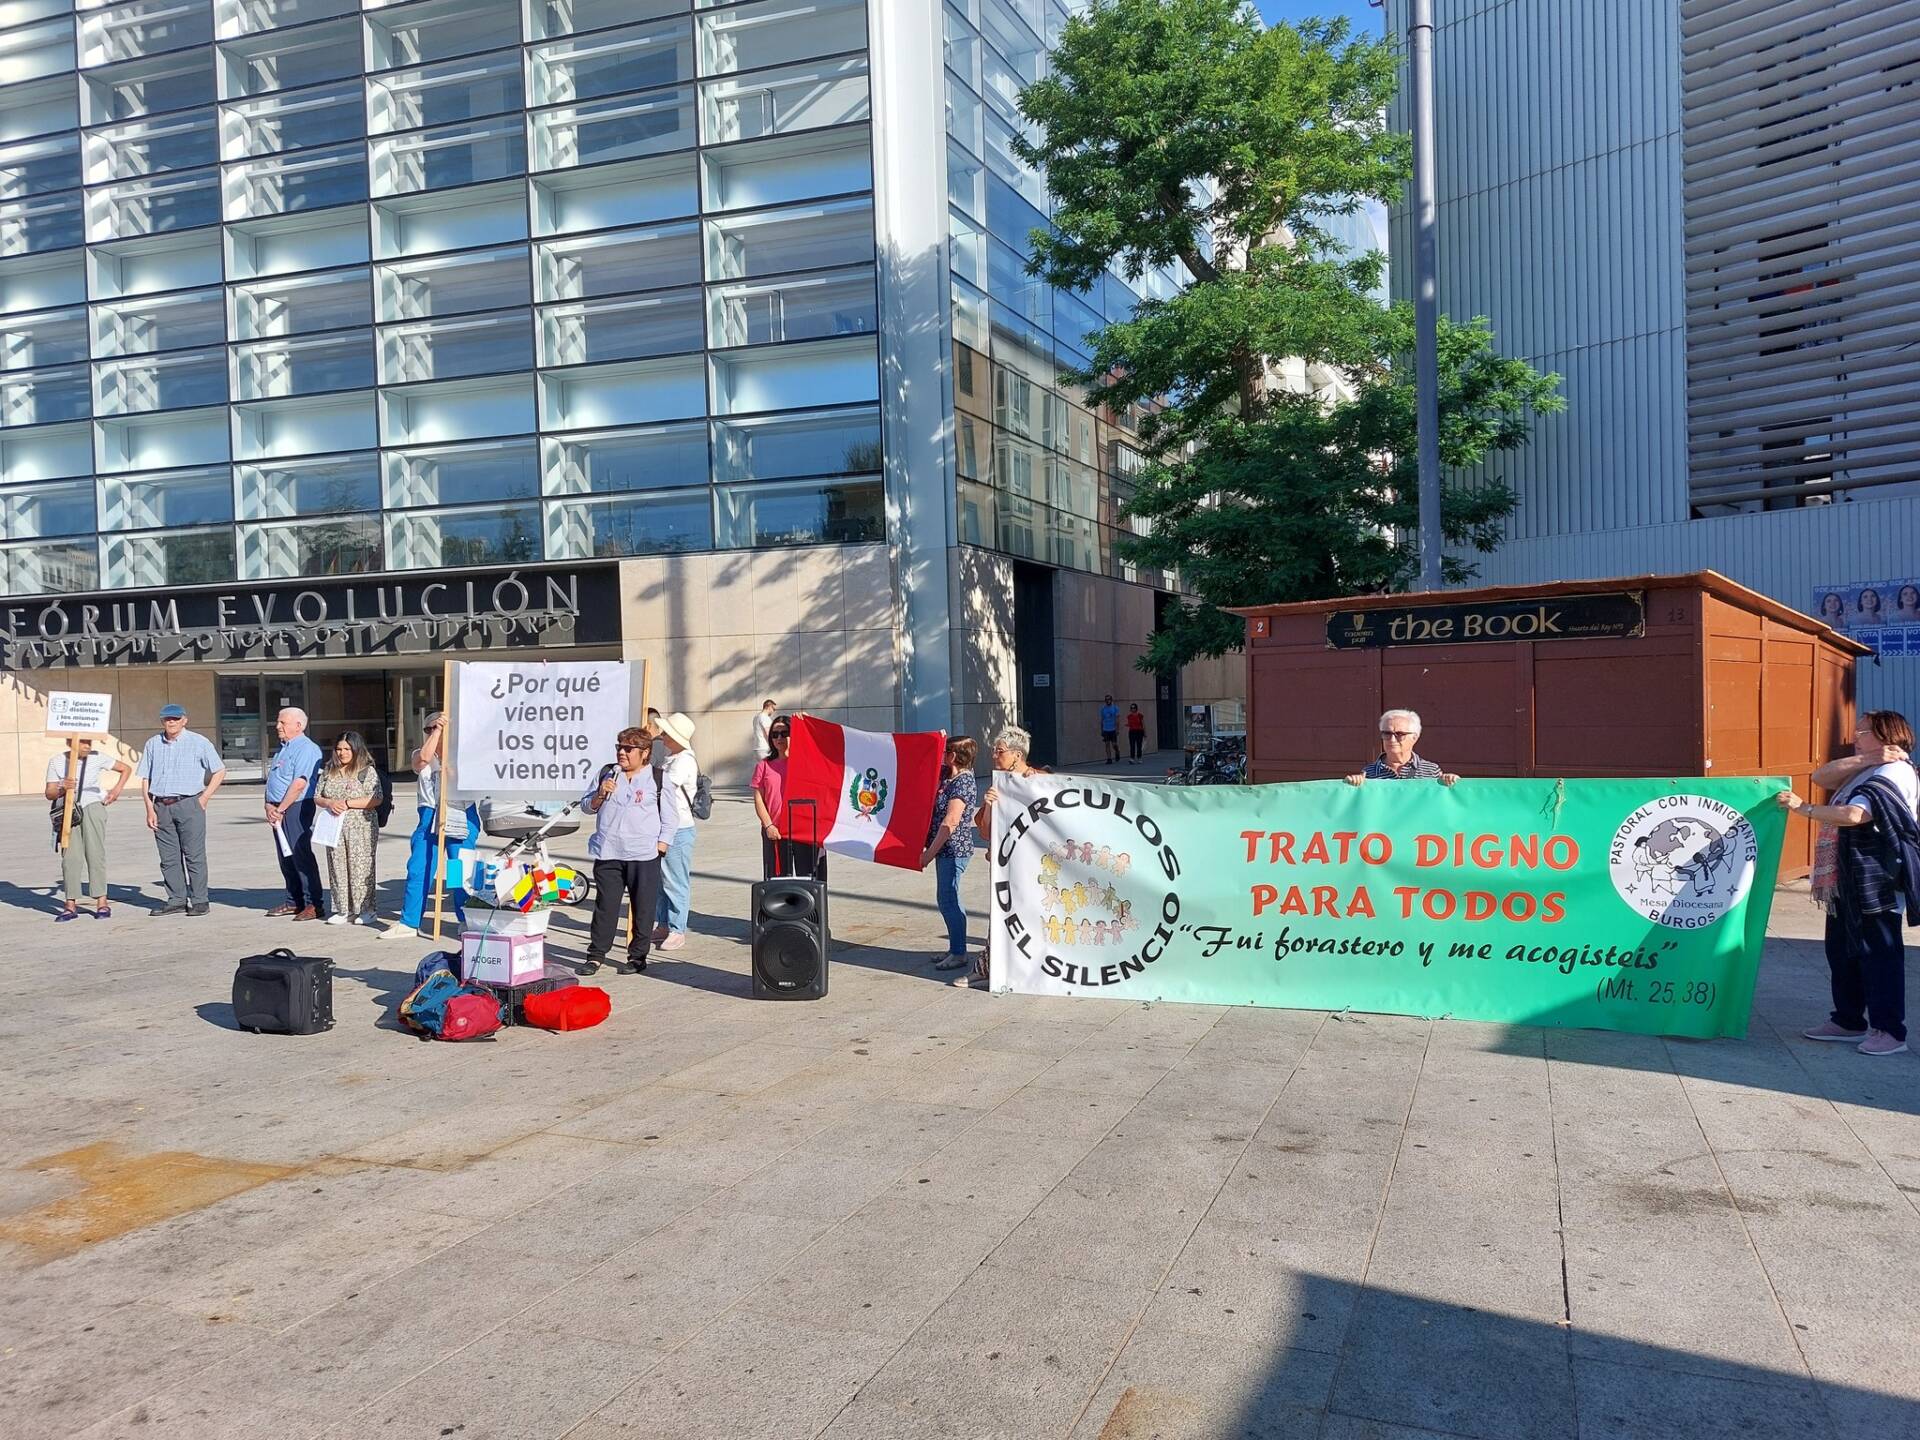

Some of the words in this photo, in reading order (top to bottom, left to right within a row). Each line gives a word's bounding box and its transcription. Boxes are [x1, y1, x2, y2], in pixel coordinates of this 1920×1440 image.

[8, 599, 180, 642] FÓRUM
[218, 570, 579, 632] EVOLUCIÓN
[11, 637, 118, 659] PALACIO
[132, 636, 161, 653] DE
[178, 623, 349, 650] CONGRESOS
[371, 623, 380, 641] Y
[403, 613, 576, 640] AUDITORIO
[1257, 621, 1264, 633] 2
[1388, 613, 1454, 640] the
[490, 672, 549, 699] ¿Por
[555, 671, 600, 697] qué
[504, 702, 584, 721] vienen
[498, 730, 534, 750] los
[543, 734, 588, 755] que
[494, 758, 592, 779] vienen?
[997, 788, 1181, 881] CIRCULOS
[1611, 807, 1653, 865] PASTORAL
[1658, 796, 1688, 809] CON
[1697, 797, 1756, 862] INMIGRANTES
[1240, 830, 1393, 865] TRATO
[1414, 832, 1580, 870] DIGNO
[1250, 884, 1376, 919] PARA
[1392, 886, 1567, 923] TODOS
[1640, 898, 1668, 907] Mesa
[1672, 899, 1724, 909] Diocesana
[1649, 909, 1716, 928] BURGOS
[995, 880, 1032, 959] DEL
[1040, 892, 1181, 986] SILENCIO
[1275, 926, 1404, 961] forastero
[1418, 941, 1435, 967] y
[1447, 940, 1493, 960] me
[471, 955, 502, 965] ACOGER
[1596, 976, 1638, 1002] (Mt.
